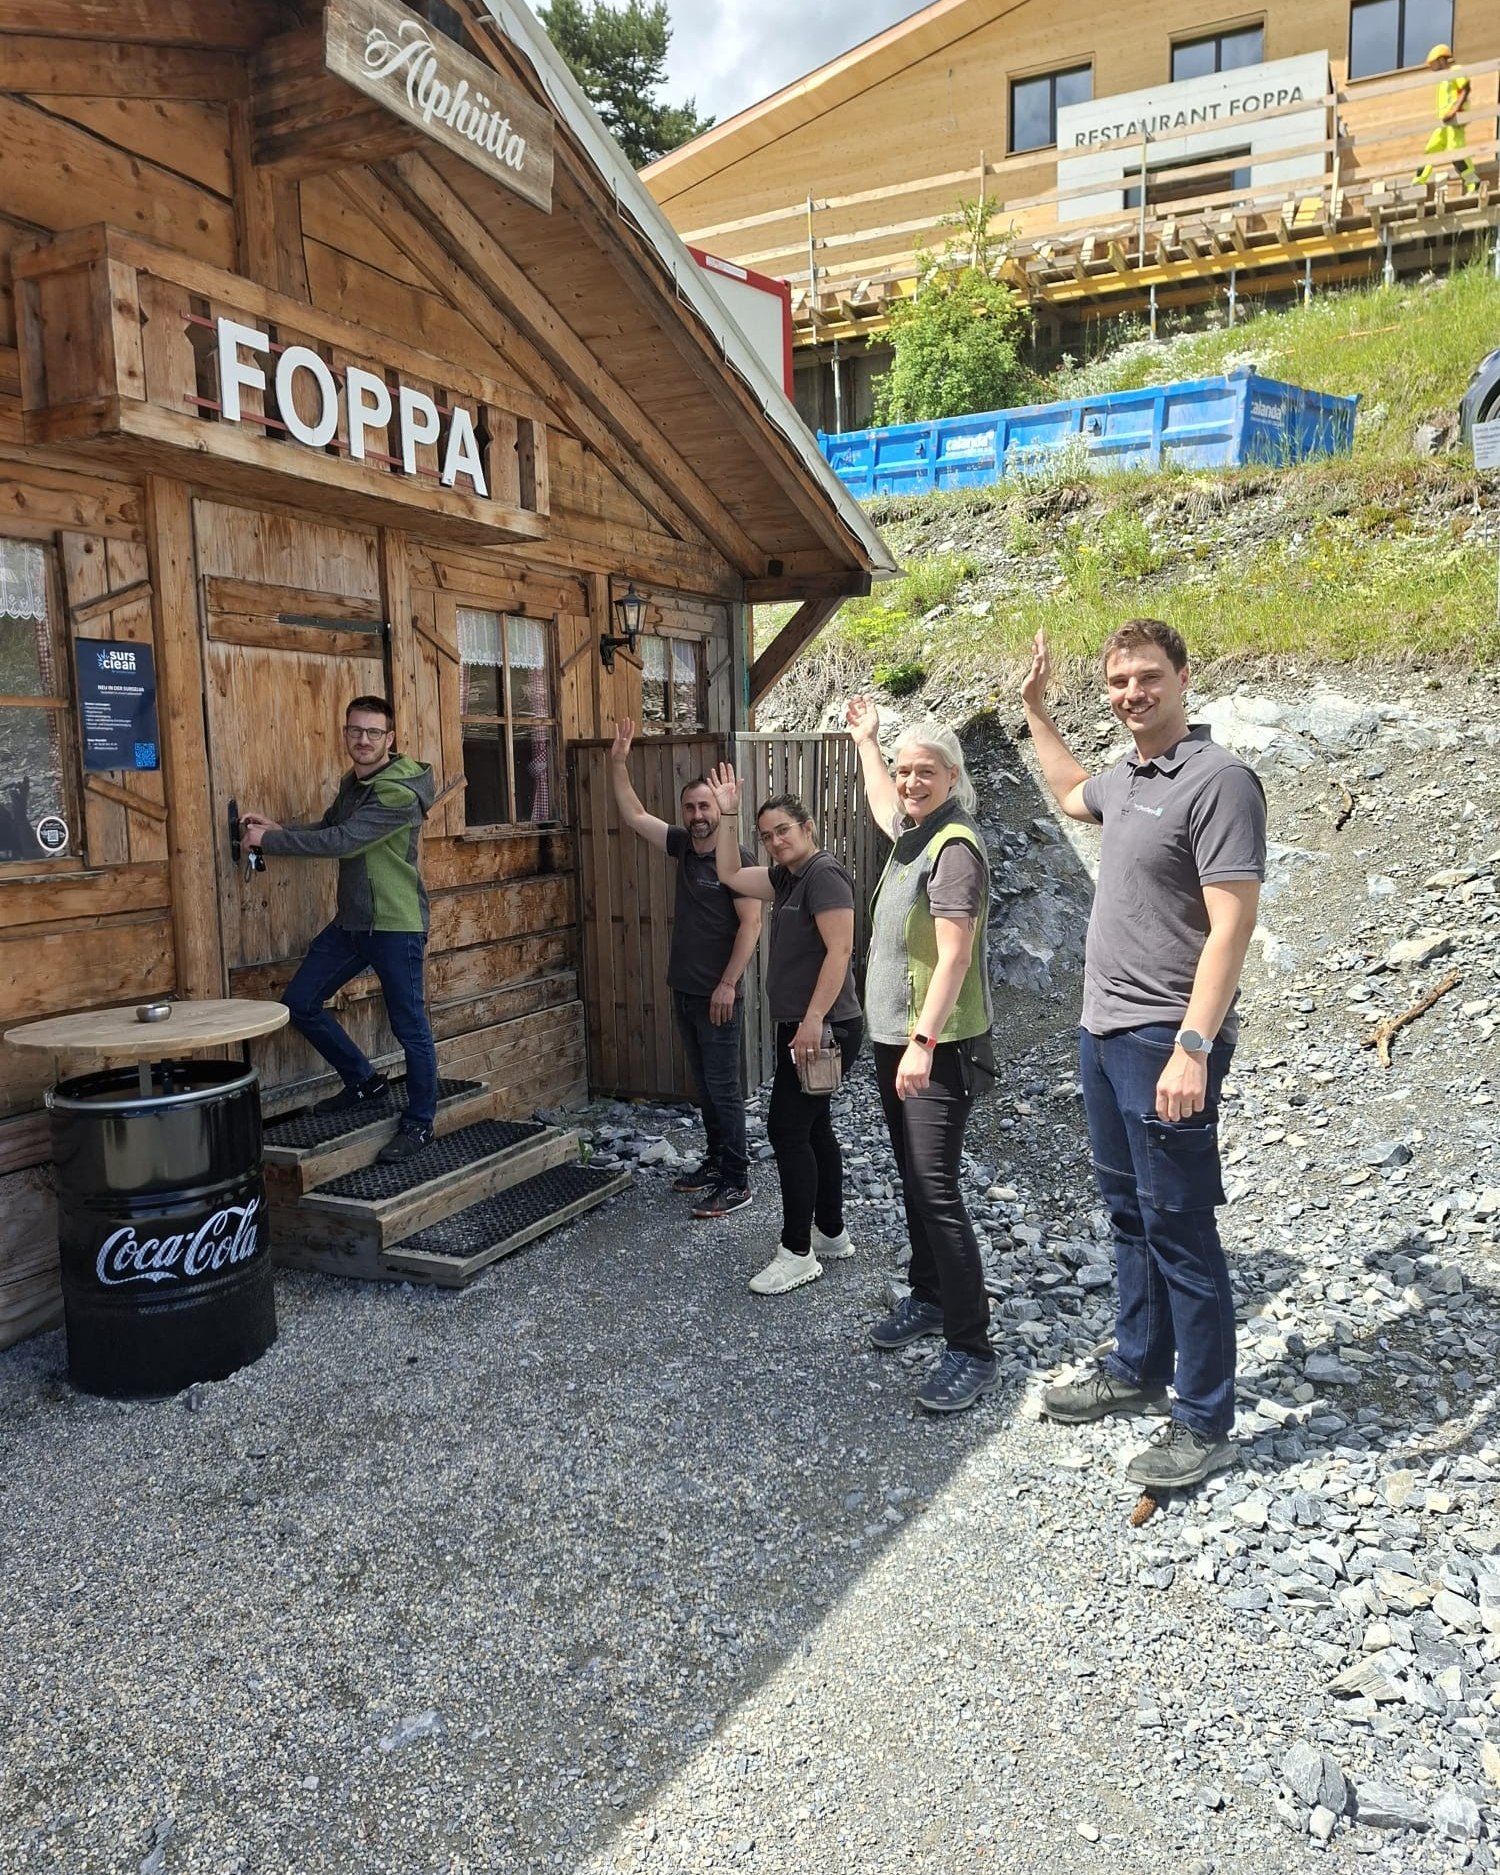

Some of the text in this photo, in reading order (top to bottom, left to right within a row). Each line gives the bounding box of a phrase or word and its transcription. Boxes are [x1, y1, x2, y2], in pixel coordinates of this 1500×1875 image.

[360, 20, 526, 172] Alphütta
[1075, 86, 1304, 147] RESTAURANT FOPPA
[217, 317, 489, 497] FOPPA
[103, 660, 136, 671] clean
[109, 651, 136, 661] surs
[96, 1195, 260, 1285] Coca-Cola
